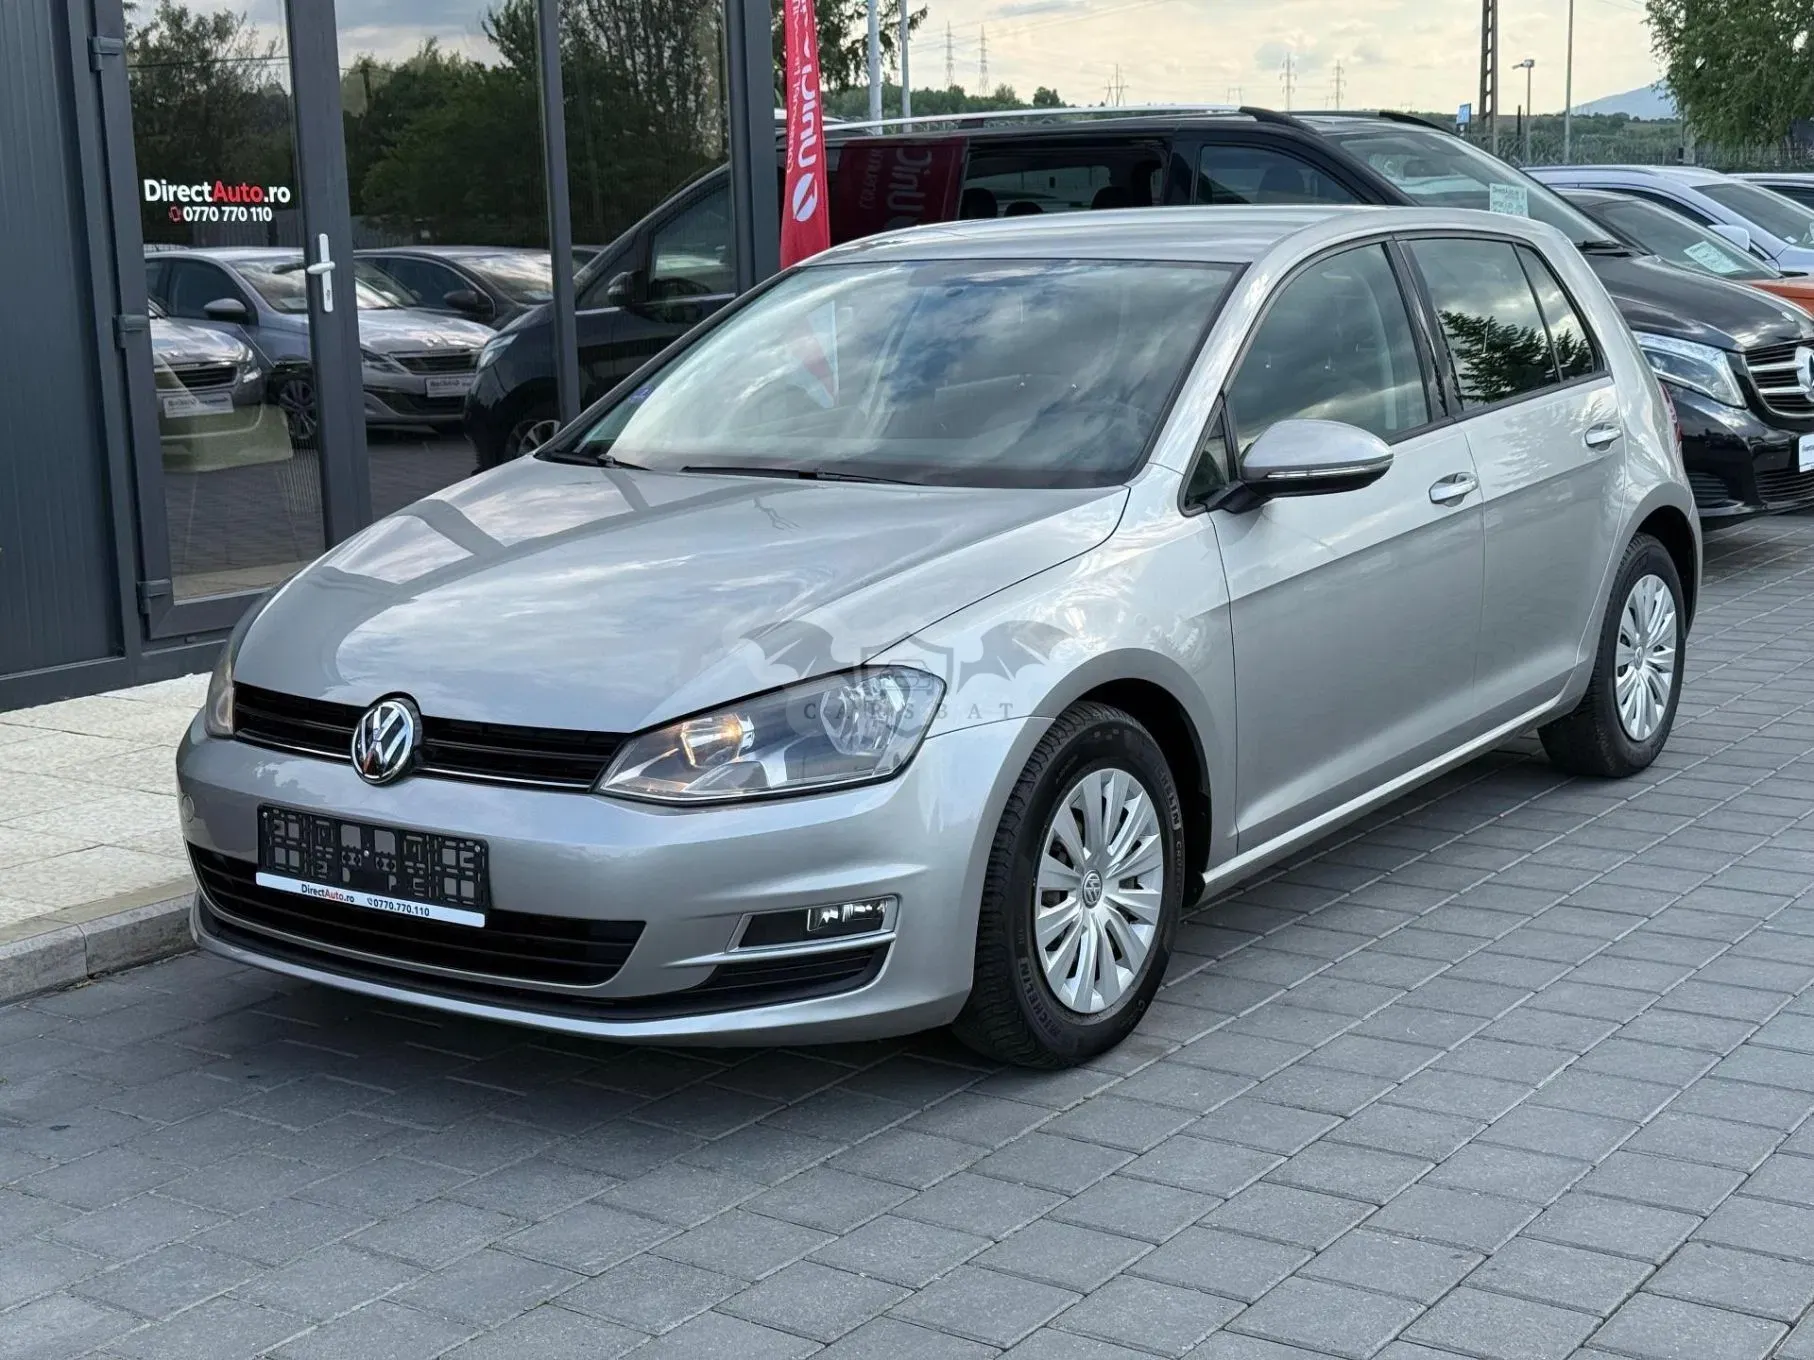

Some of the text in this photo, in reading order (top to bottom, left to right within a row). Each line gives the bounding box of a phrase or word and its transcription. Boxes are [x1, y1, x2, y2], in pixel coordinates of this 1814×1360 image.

[143, 178, 291, 204] DirectAuto.ro
[182, 206, 273, 222] 0770 770 110
[301, 883, 430, 918] DirectAuto.ro 0770.770.110
